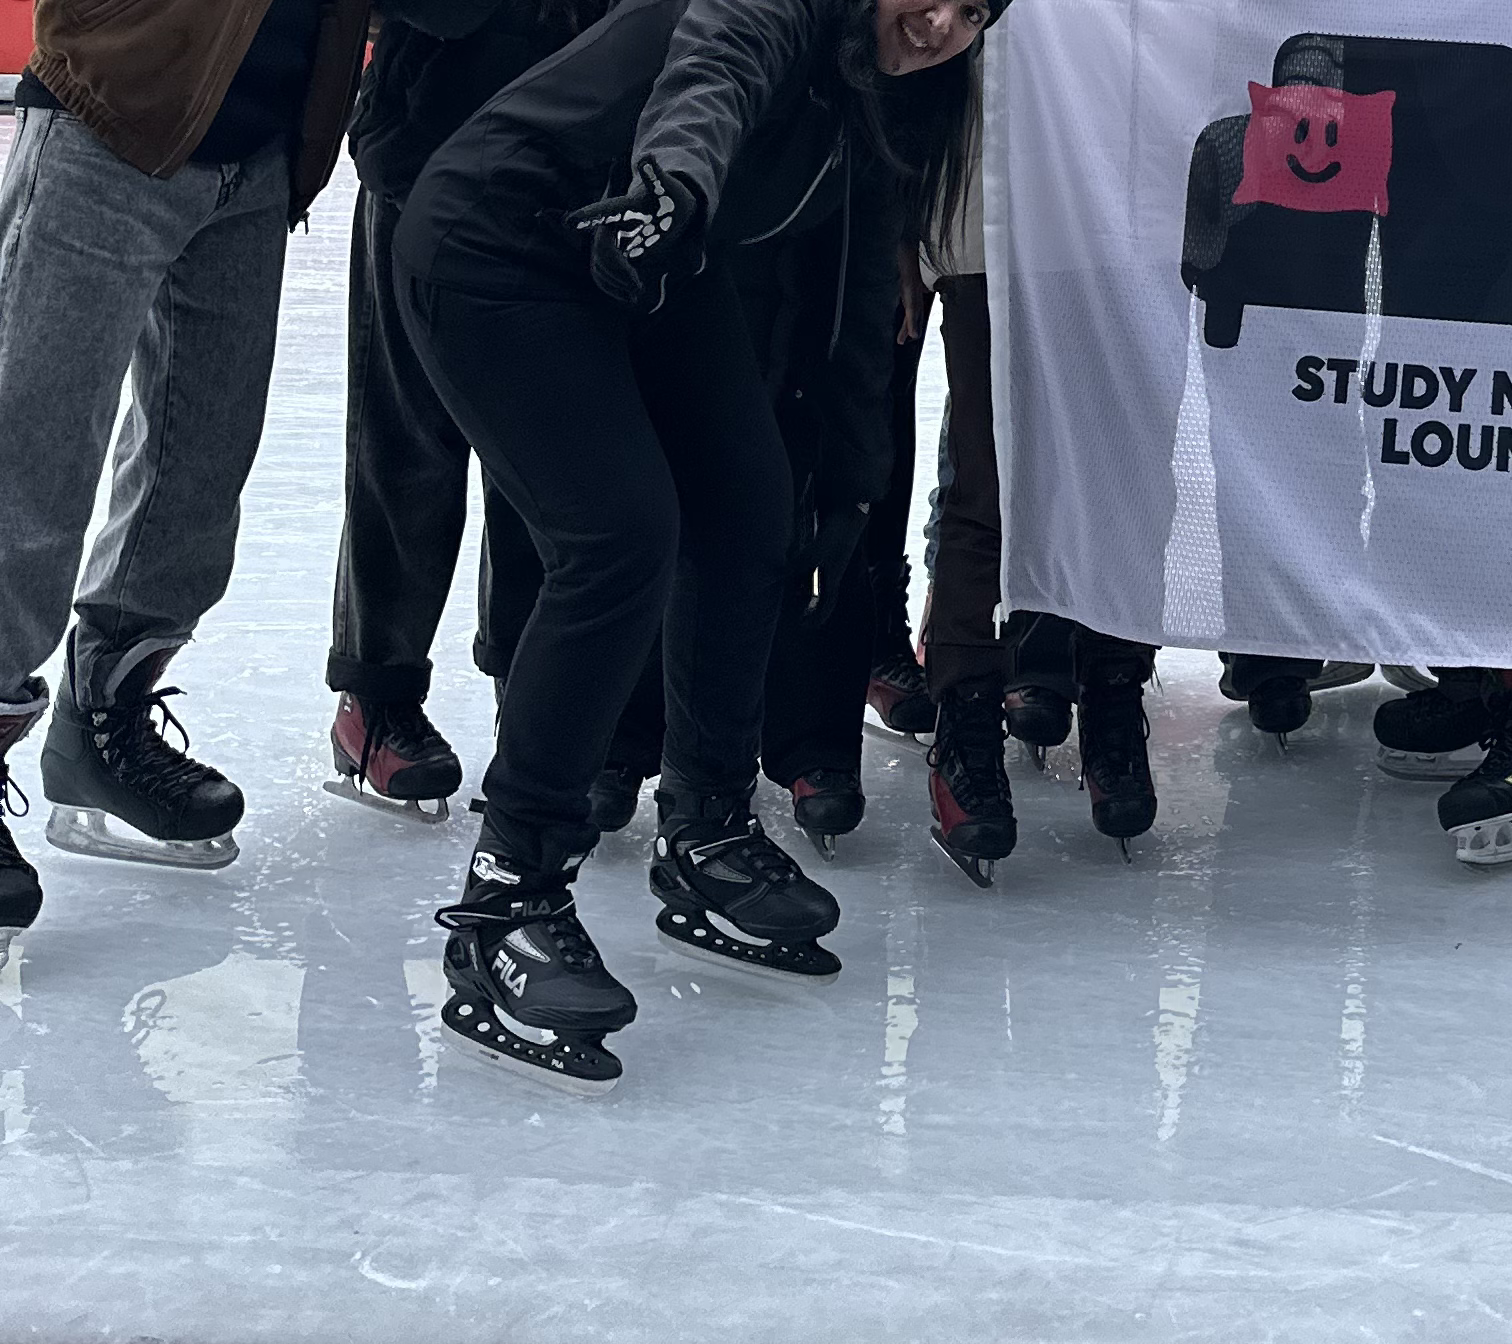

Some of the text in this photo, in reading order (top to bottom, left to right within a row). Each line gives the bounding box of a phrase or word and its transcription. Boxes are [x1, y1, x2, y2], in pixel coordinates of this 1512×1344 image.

[1291, 354, 1478, 413] STUDY
[511, 899, 551, 919] FILA
[491, 949, 528, 999] FILA
